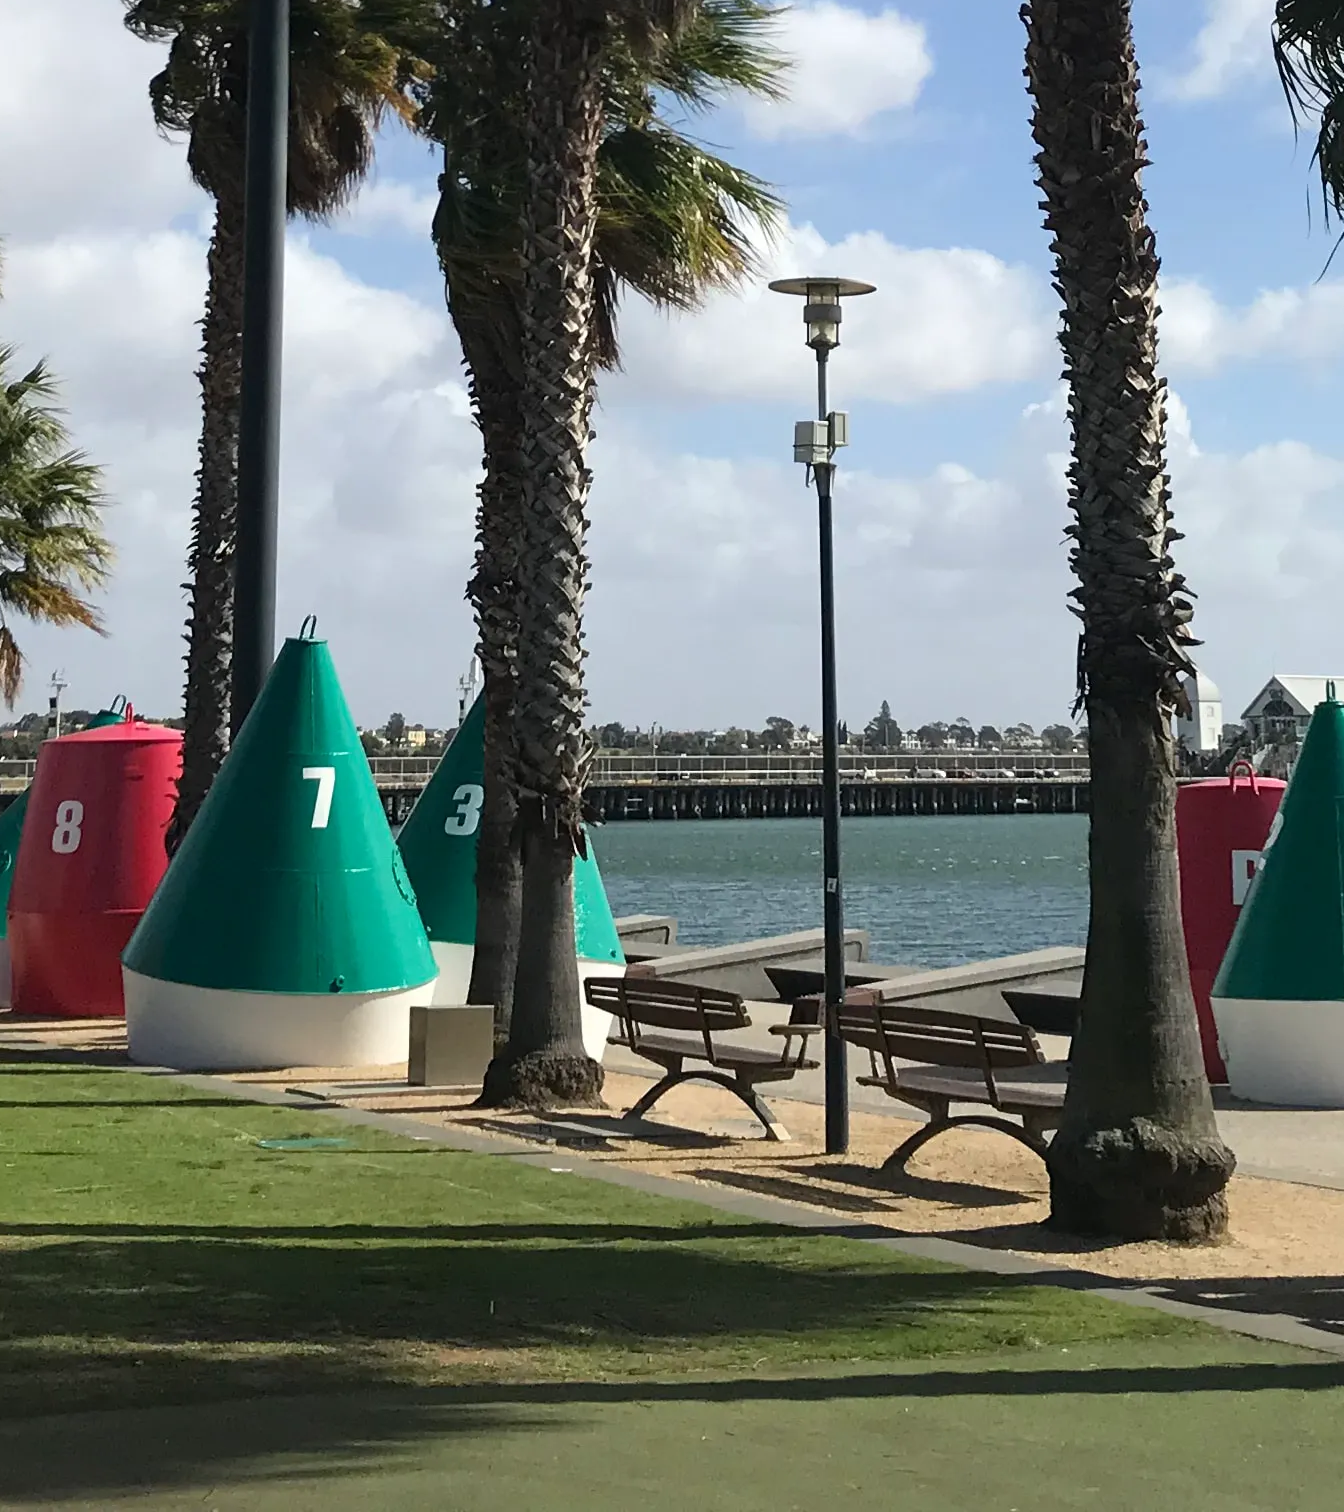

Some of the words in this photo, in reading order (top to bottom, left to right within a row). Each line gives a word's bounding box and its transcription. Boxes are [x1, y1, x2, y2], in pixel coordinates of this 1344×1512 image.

[302, 767, 336, 828] 7
[444, 784, 484, 836] 3
[51, 800, 84, 854] 8
